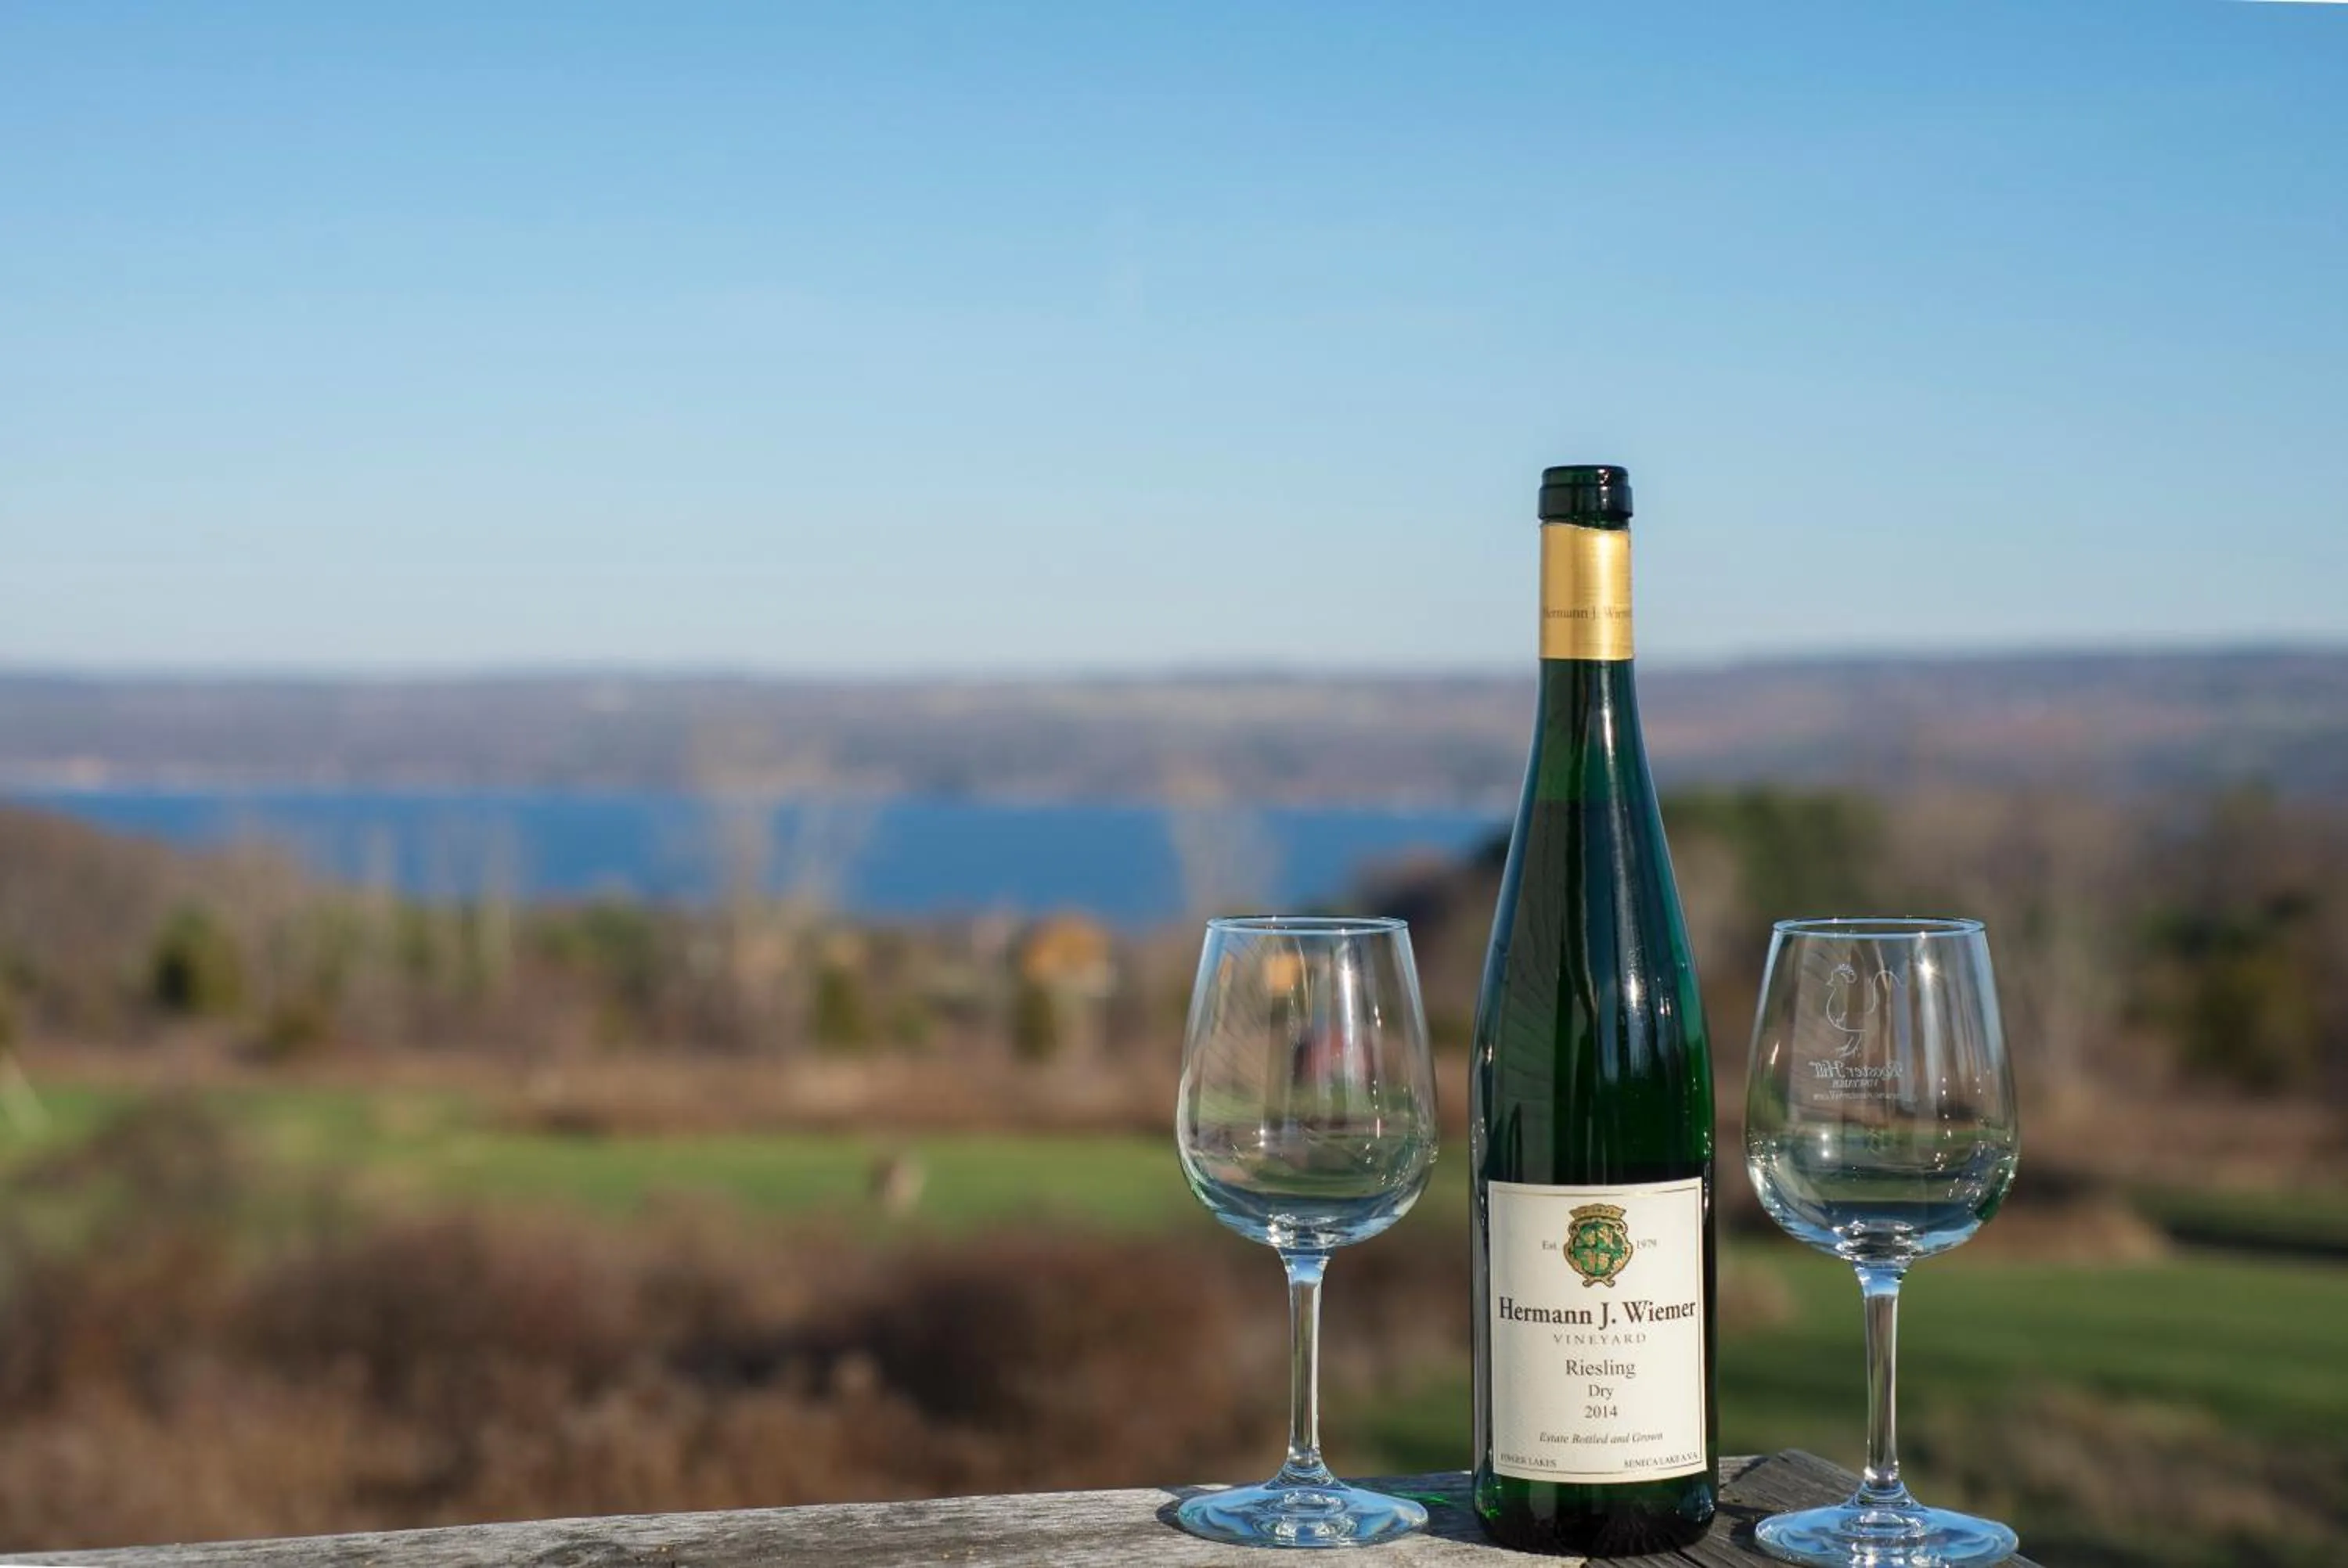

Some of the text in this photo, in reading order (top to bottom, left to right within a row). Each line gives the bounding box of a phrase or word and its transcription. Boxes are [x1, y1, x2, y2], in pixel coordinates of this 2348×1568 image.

[1500, 1296, 1695, 1330] Hermann J. Wiemer
[1554, 1332, 1647, 1344] VINEYARD
[1566, 1359, 1636, 1379] Riesling
[1589, 1384, 1614, 1400] Dry
[1585, 1405, 1618, 1419] 2014
[1540, 1432, 1663, 1444] Estate Bottled and Grown
[1529, 1457, 1557, 1468] LAKES
[1624, 1457, 1658, 1468] SENECA
